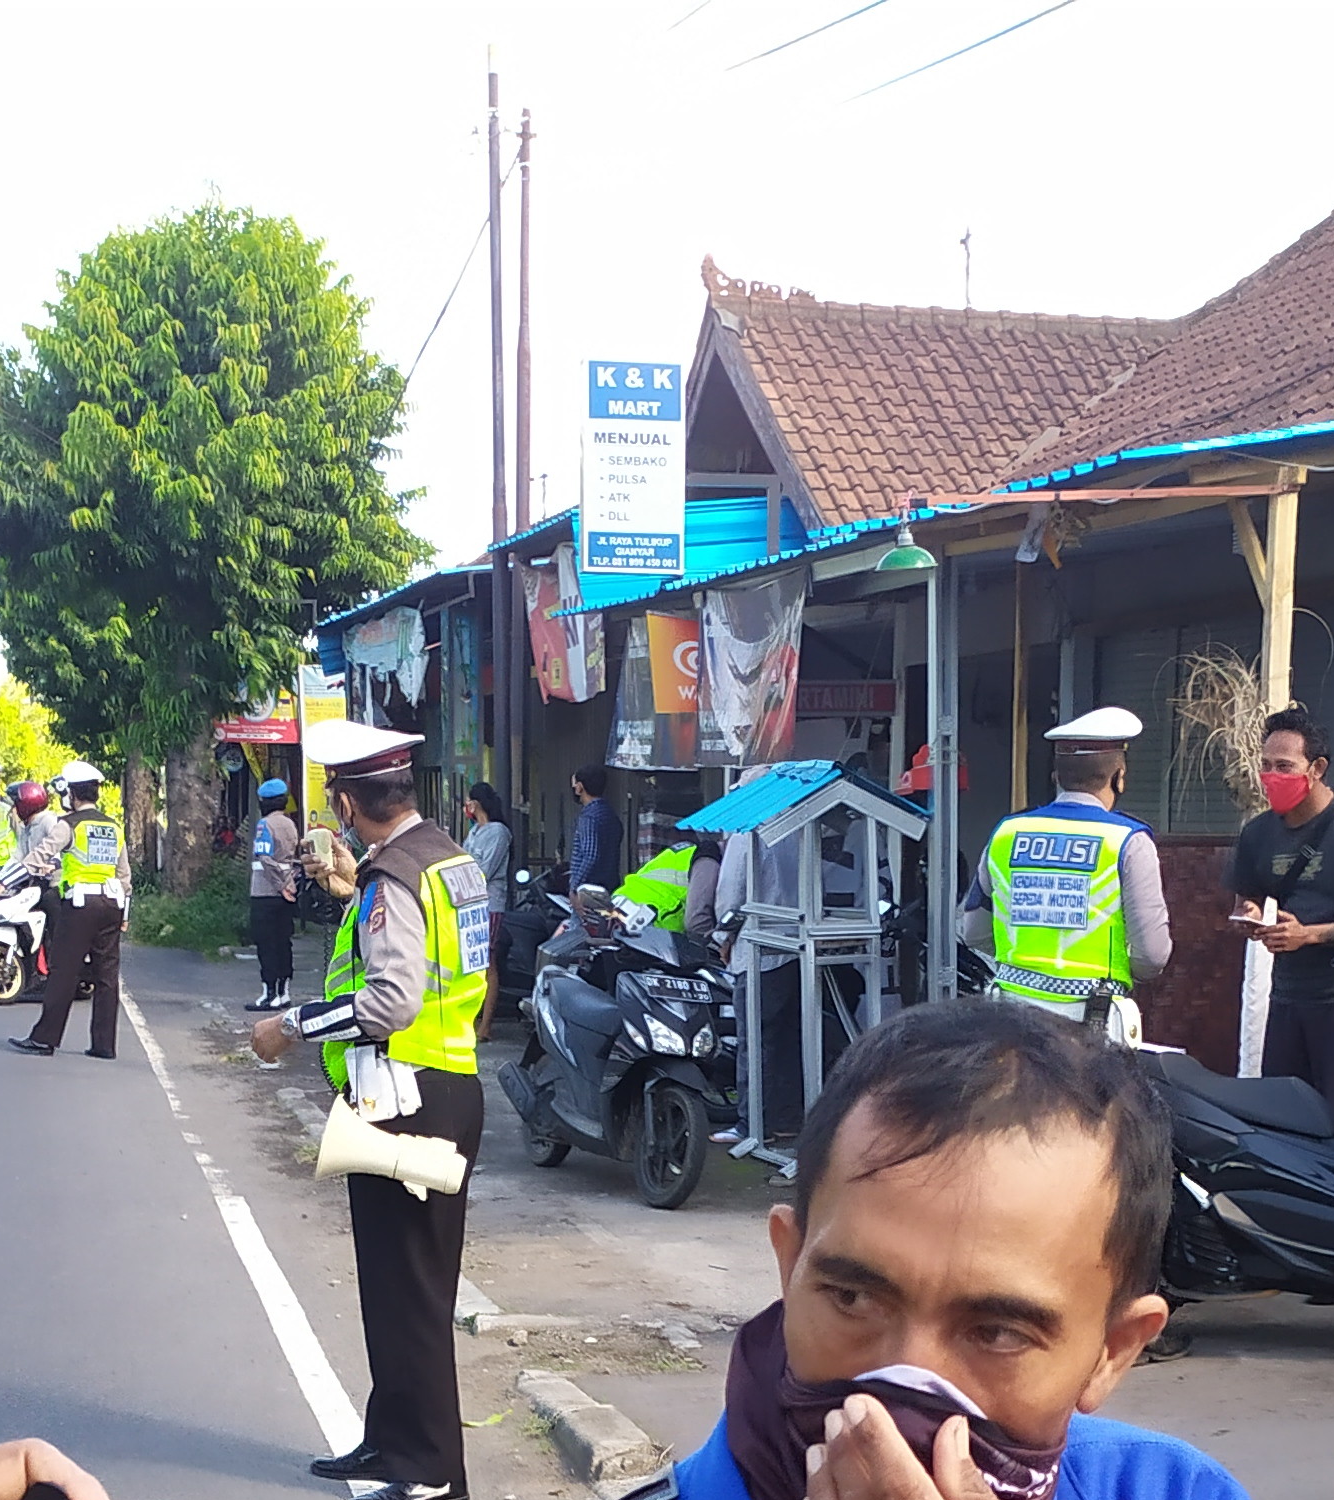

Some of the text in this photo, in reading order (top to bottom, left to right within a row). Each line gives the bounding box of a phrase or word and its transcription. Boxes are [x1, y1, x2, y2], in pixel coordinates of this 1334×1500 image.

[596, 366, 673, 389] K & K
[608, 400, 661, 416] MART
[594, 432, 672, 446] MENJUAL
[608, 456, 667, 467] SEMBAKO
[608, 474, 647, 485] PULSA
[608, 493, 631, 503] ATK
[608, 512, 630, 521] DLL
[610, 537, 633, 546] RAYA
[1013, 837, 1099, 864] POLISI
